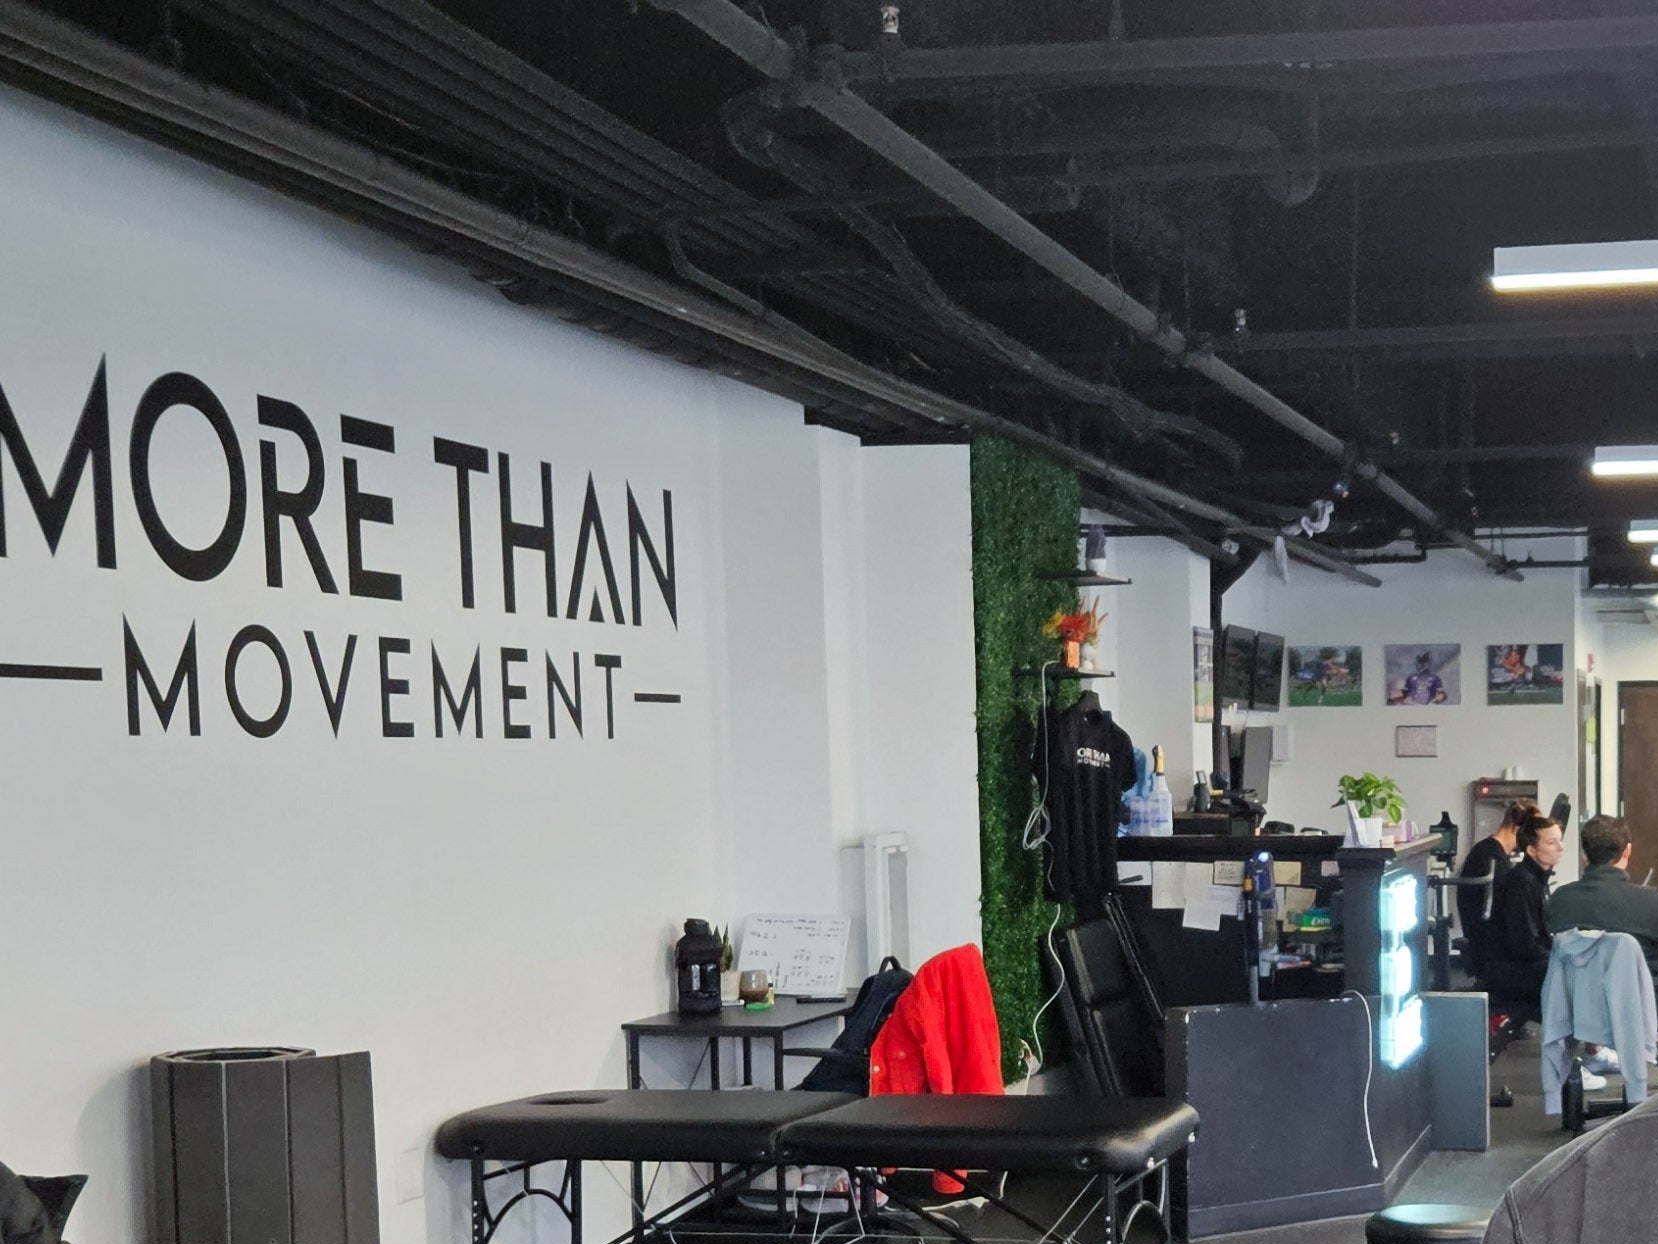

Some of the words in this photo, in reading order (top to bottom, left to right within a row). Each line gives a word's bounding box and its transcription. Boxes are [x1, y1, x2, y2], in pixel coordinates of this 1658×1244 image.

[0, 351, 403, 602] MORE
[432, 435, 679, 631] THAN
[121, 611, 623, 740] MOVEMENT
